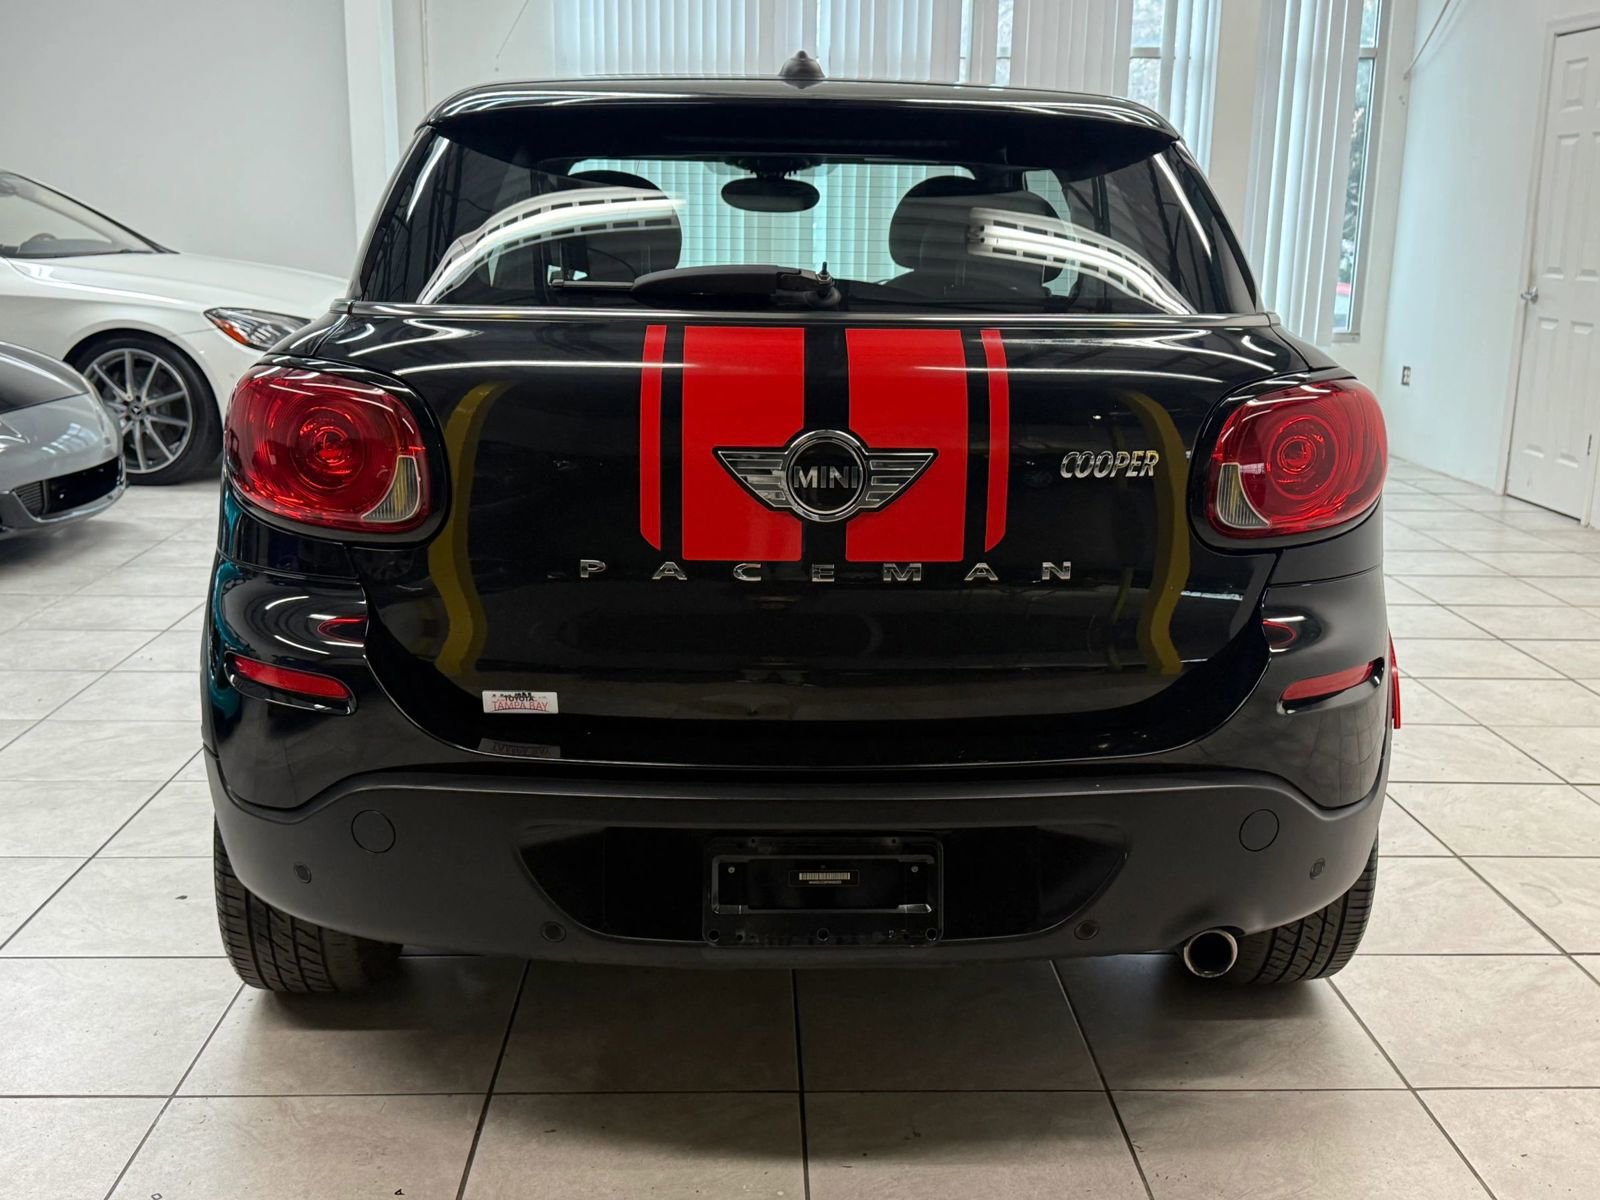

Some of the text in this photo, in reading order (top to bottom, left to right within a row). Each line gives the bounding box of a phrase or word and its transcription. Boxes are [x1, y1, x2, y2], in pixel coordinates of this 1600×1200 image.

[1060, 450, 1160, 478] COOPER
[793, 465, 858, 490] MINI
[579, 558, 1073, 582] PACEMAN
[493, 701, 548, 711] TAMPA BAY
